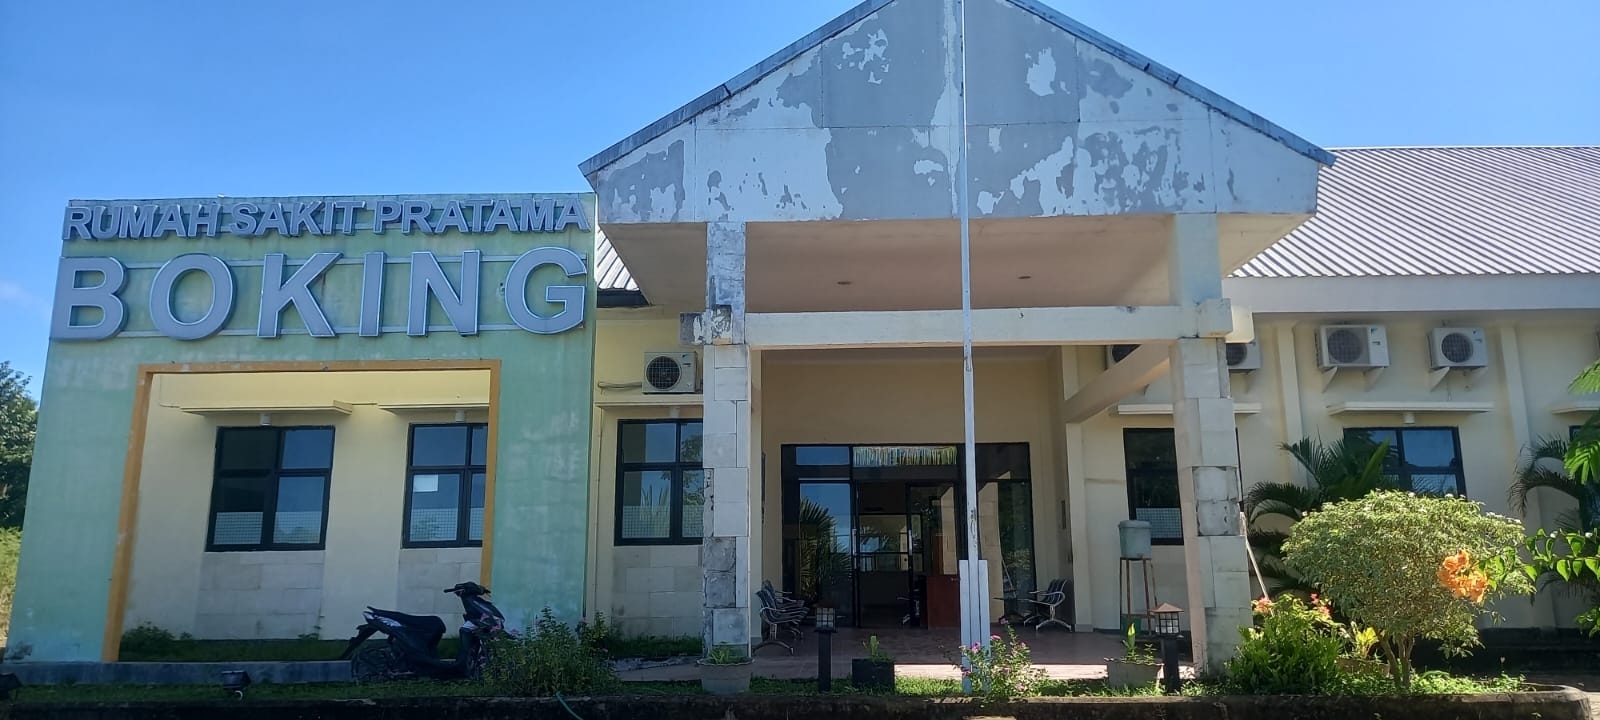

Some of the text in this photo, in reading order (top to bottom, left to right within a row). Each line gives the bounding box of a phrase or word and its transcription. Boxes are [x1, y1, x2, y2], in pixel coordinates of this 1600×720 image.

[63, 199, 590, 240] RUMAH SAKIT PRATAMA
[50, 247, 587, 341] BOKING
